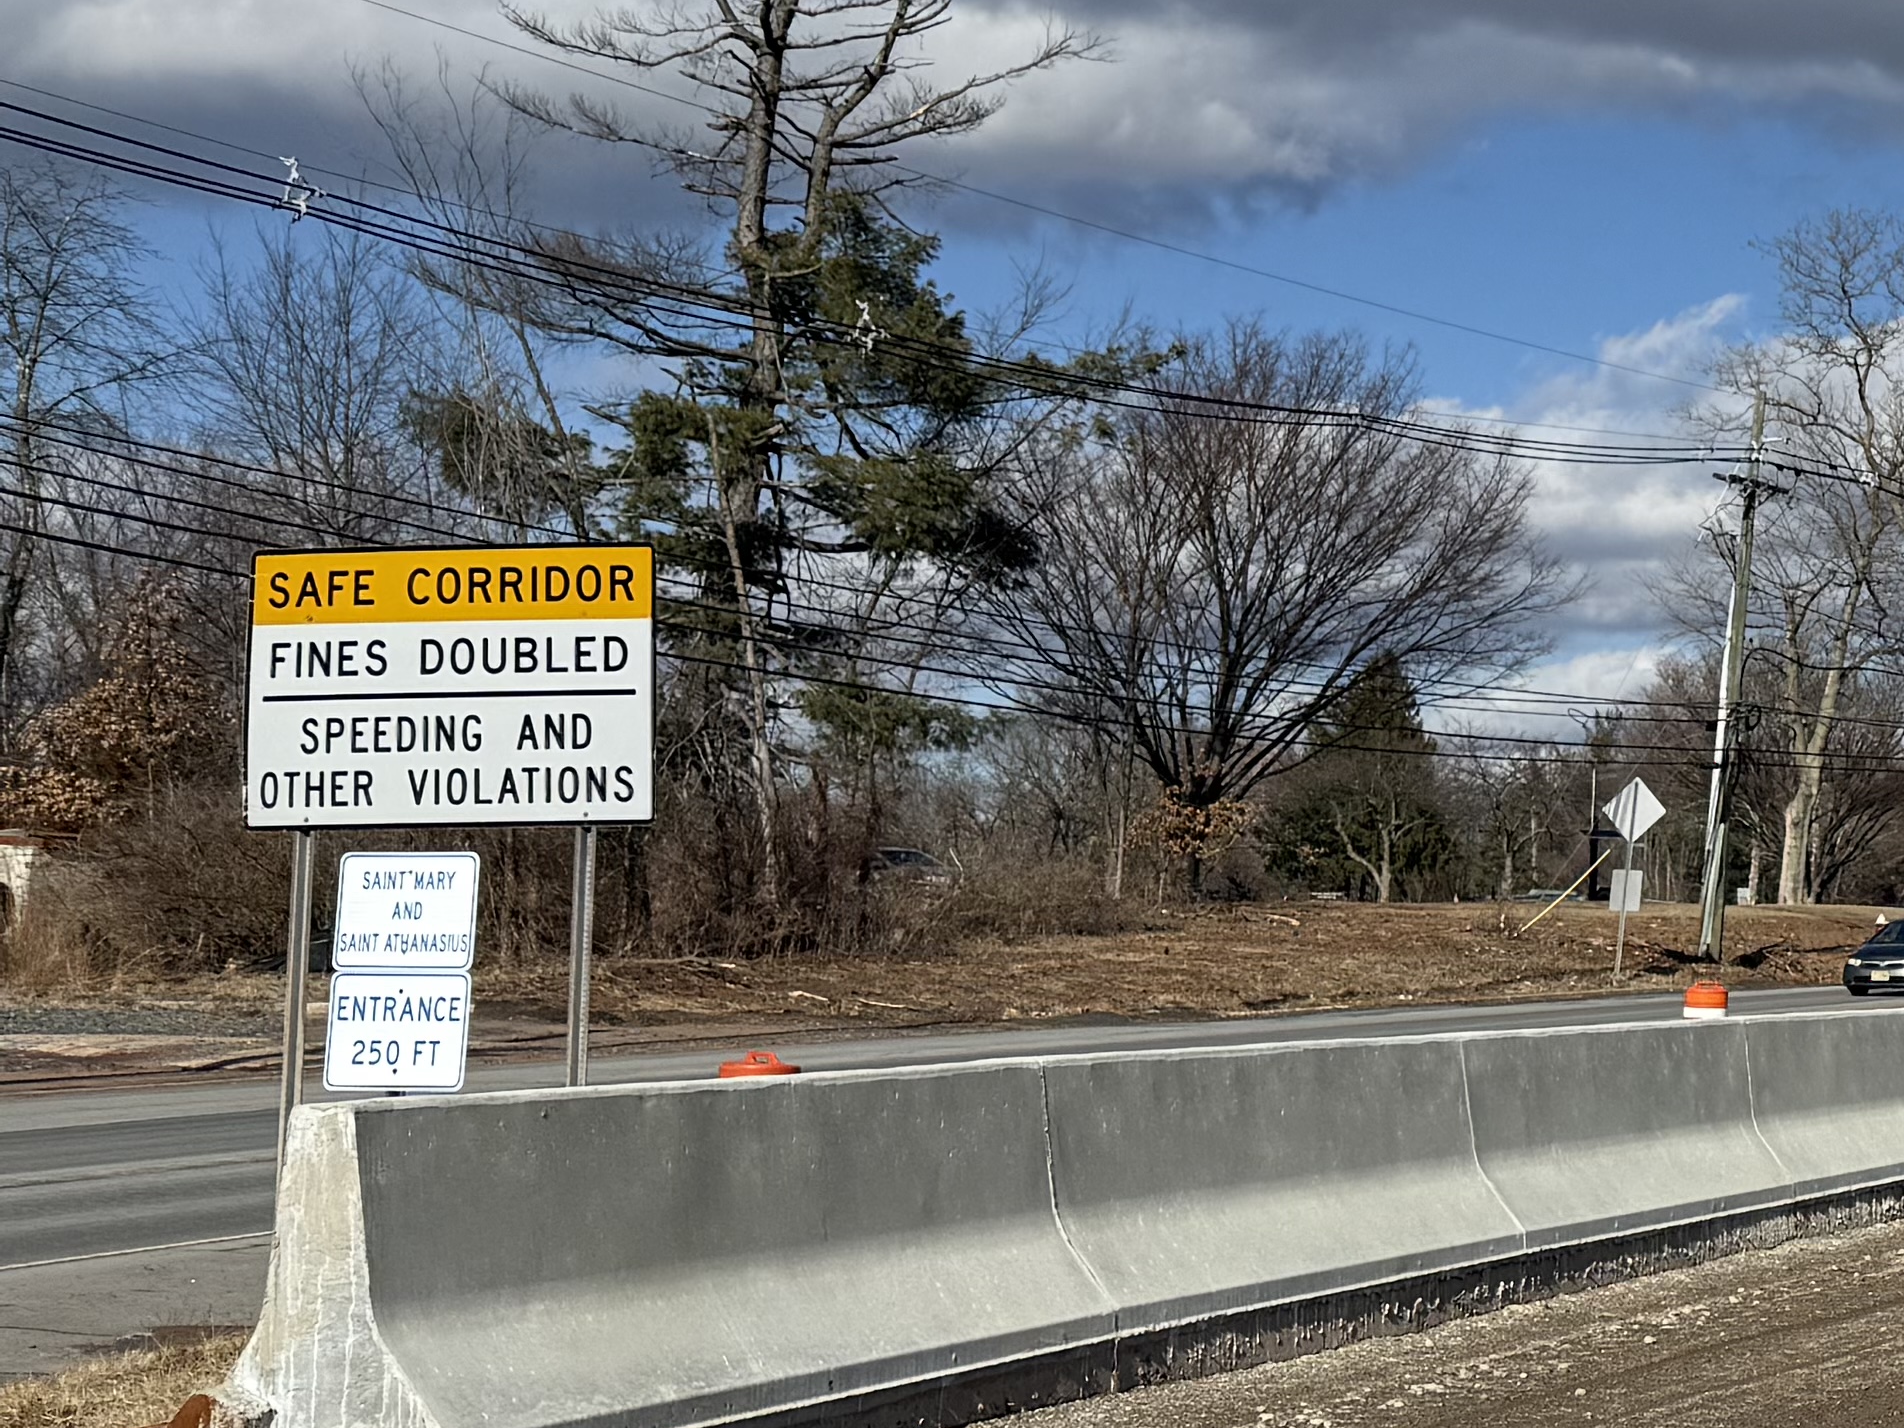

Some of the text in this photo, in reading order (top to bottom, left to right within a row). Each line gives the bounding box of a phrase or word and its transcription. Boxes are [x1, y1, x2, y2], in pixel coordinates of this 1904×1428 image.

[268, 564, 635, 609] SAFE CORRIDOR
[269, 635, 629, 678] FINES DOUBLED
[299, 713, 593, 755] SPEEDING AND
[259, 765, 635, 809] OTHER VIOLATIONS
[362, 870, 457, 890] SAINT MARY
[391, 901, 423, 920] AND
[339, 933, 468, 952] SAINT ATHANASIUS
[337, 995, 462, 1022] ENTRANCE
[351, 1040, 441, 1066] 250 FT
